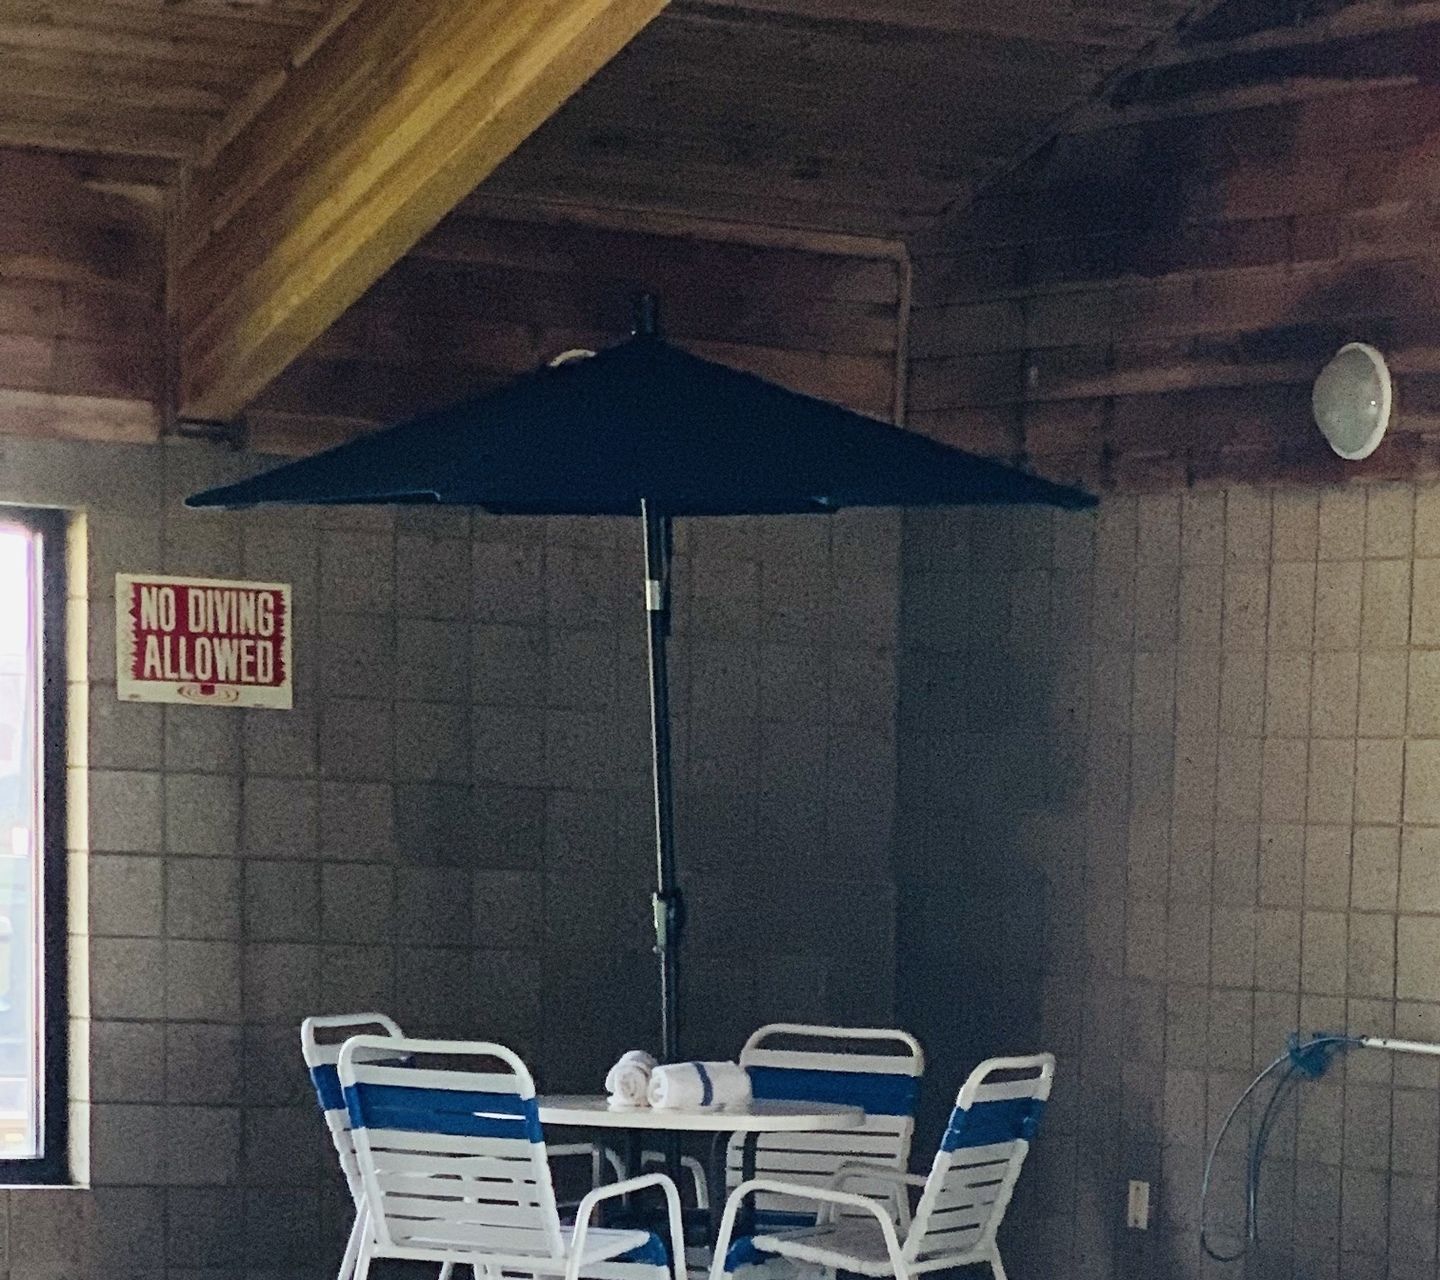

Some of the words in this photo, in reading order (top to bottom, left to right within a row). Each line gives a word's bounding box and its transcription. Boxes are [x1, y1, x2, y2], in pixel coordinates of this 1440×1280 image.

[140, 586, 176, 632] NO
[187, 588, 275, 637] DIVING
[143, 635, 275, 684] ALLOWED
